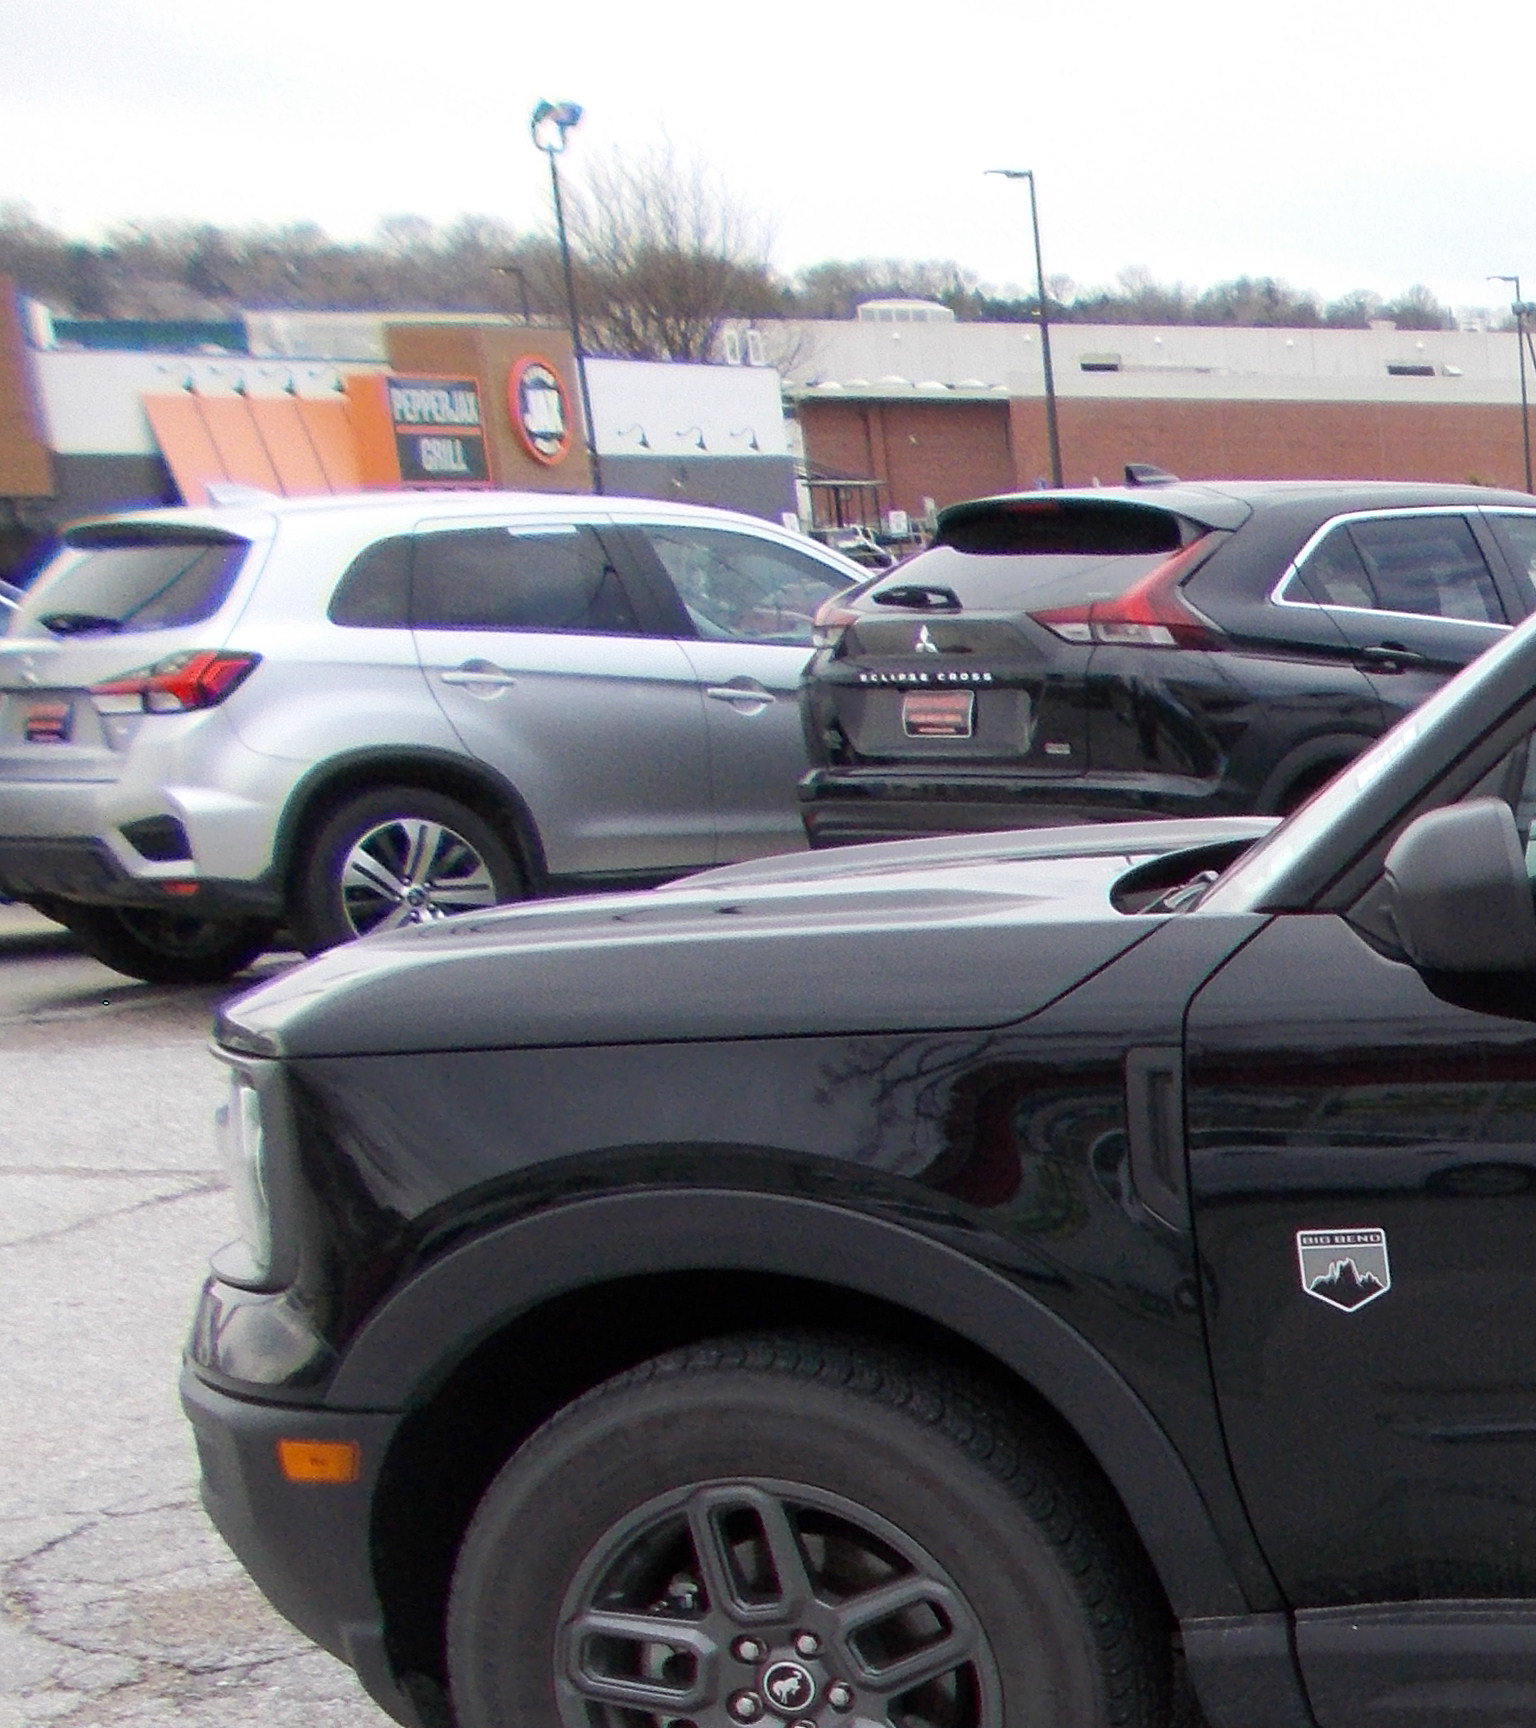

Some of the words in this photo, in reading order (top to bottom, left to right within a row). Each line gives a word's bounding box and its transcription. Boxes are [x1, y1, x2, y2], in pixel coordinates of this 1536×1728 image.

[390, 387, 480, 425] PEPPERJAX
[523, 388, 565, 433] JAX
[420, 436, 470, 473] GRILL
[859, 672, 929, 683] ECLIPSE
[936, 672, 993, 682] CROSS
[1302, 1235, 1331, 1245] BIG
[1334, 1233, 1381, 1244] BEND
